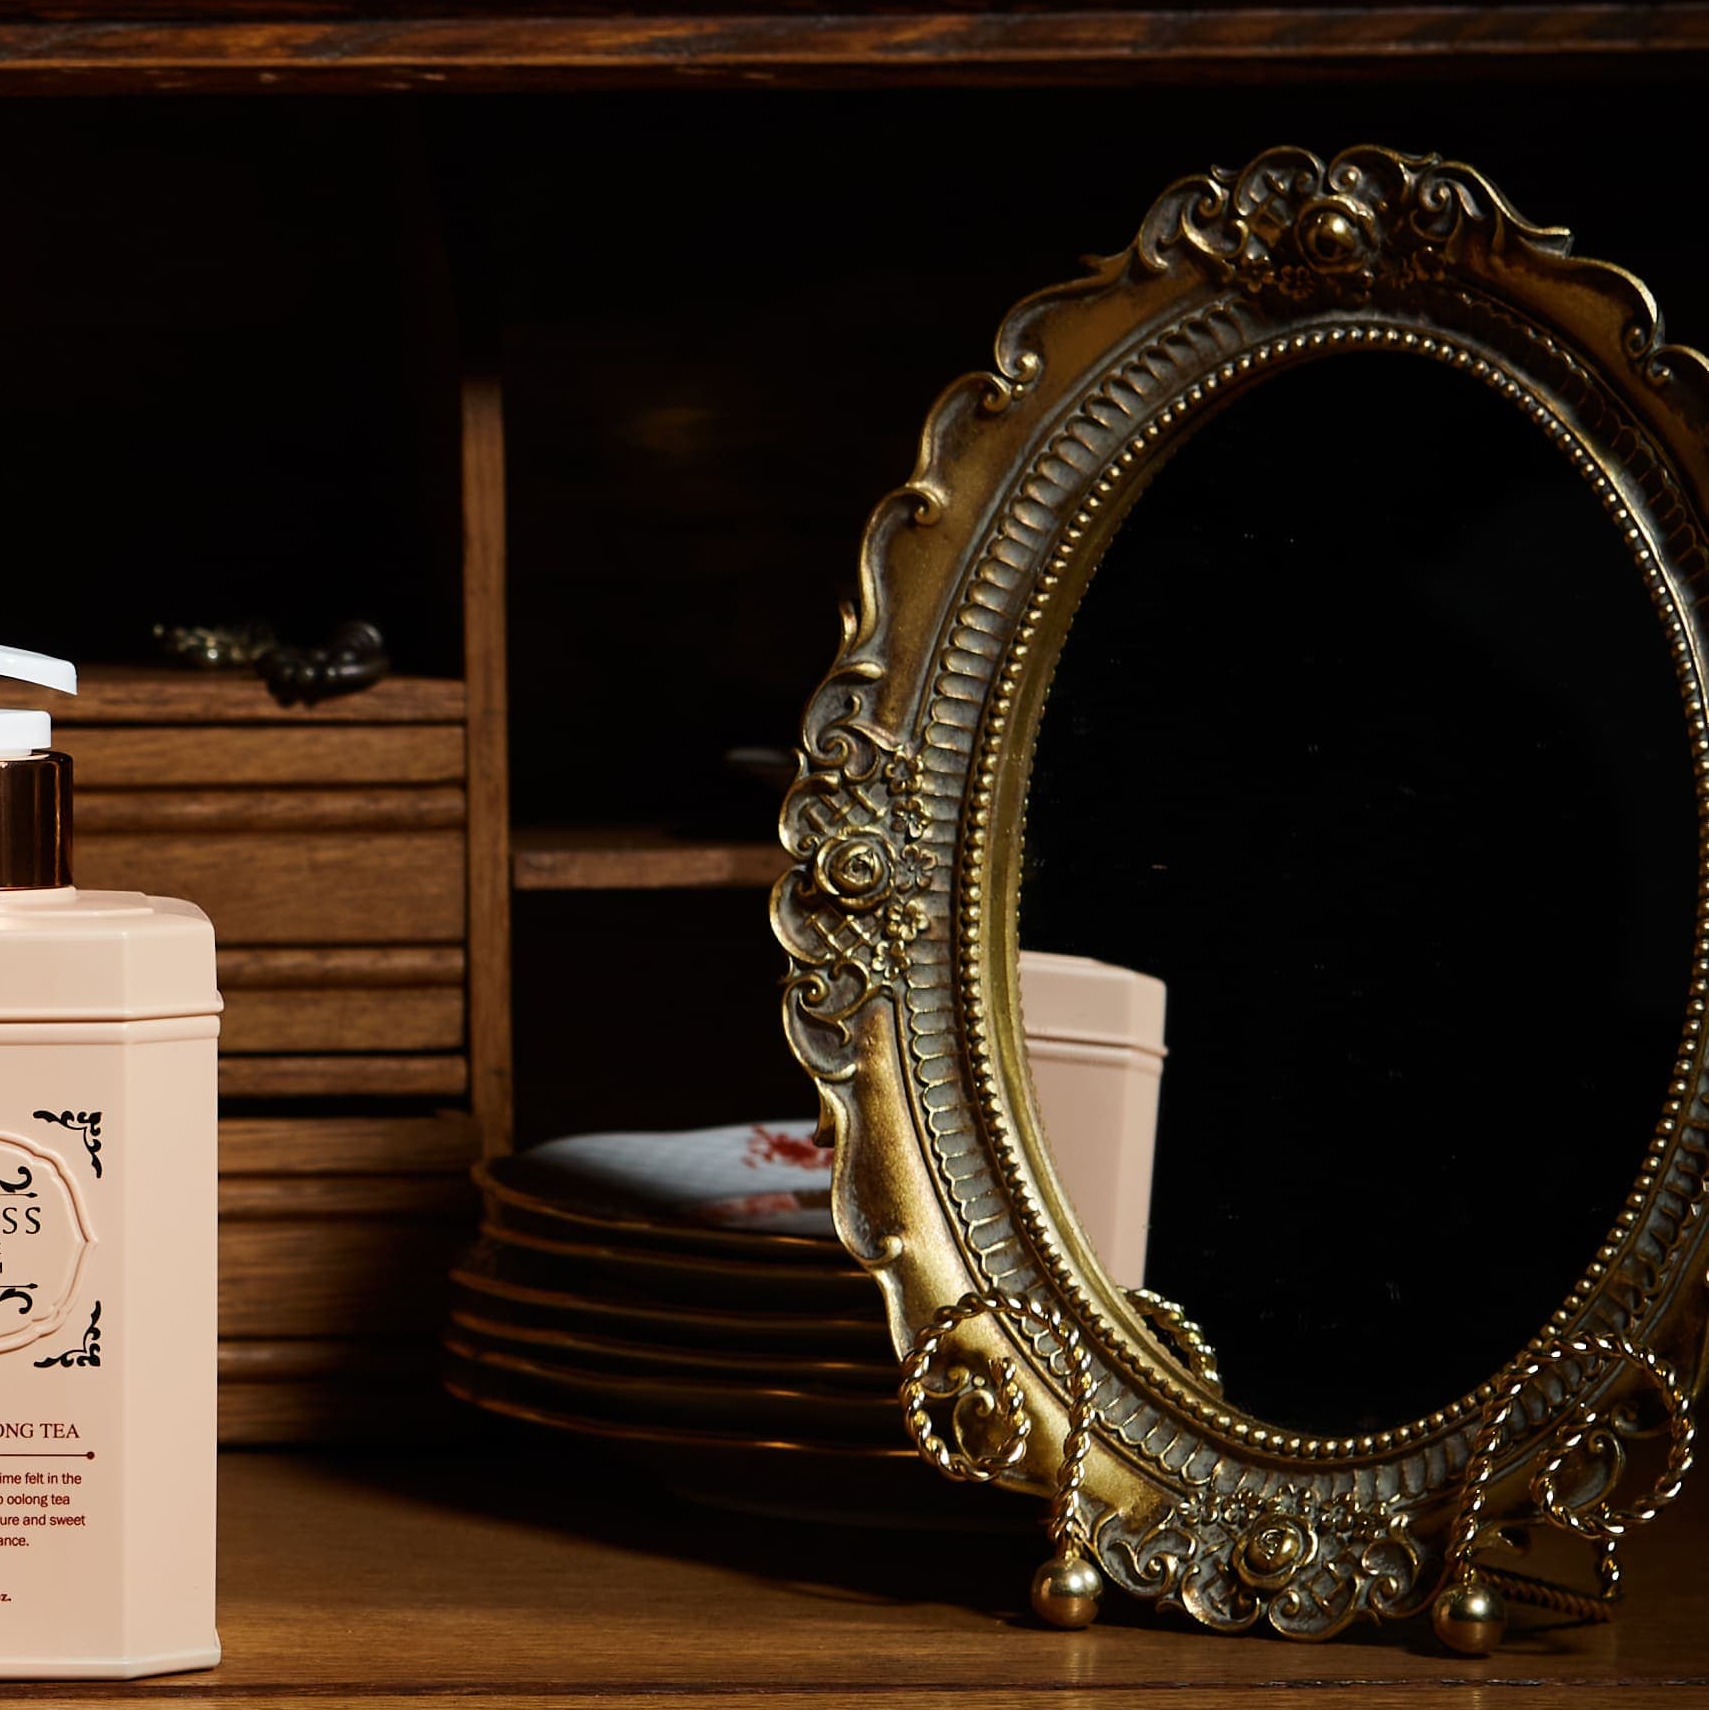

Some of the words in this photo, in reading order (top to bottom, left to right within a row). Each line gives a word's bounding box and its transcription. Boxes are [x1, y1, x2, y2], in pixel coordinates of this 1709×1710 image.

[39, 1423, 80, 1438] TEA
[25, 1472, 44, 1485] felt
[47, 1472, 58, 1484] in
[62, 1472, 82, 1485] the
[7, 1493, 48, 1508] oolong
[51, 1494, 70, 1505] tea
[22, 1514, 46, 1526] and
[49, 1515, 86, 1526] sweet
